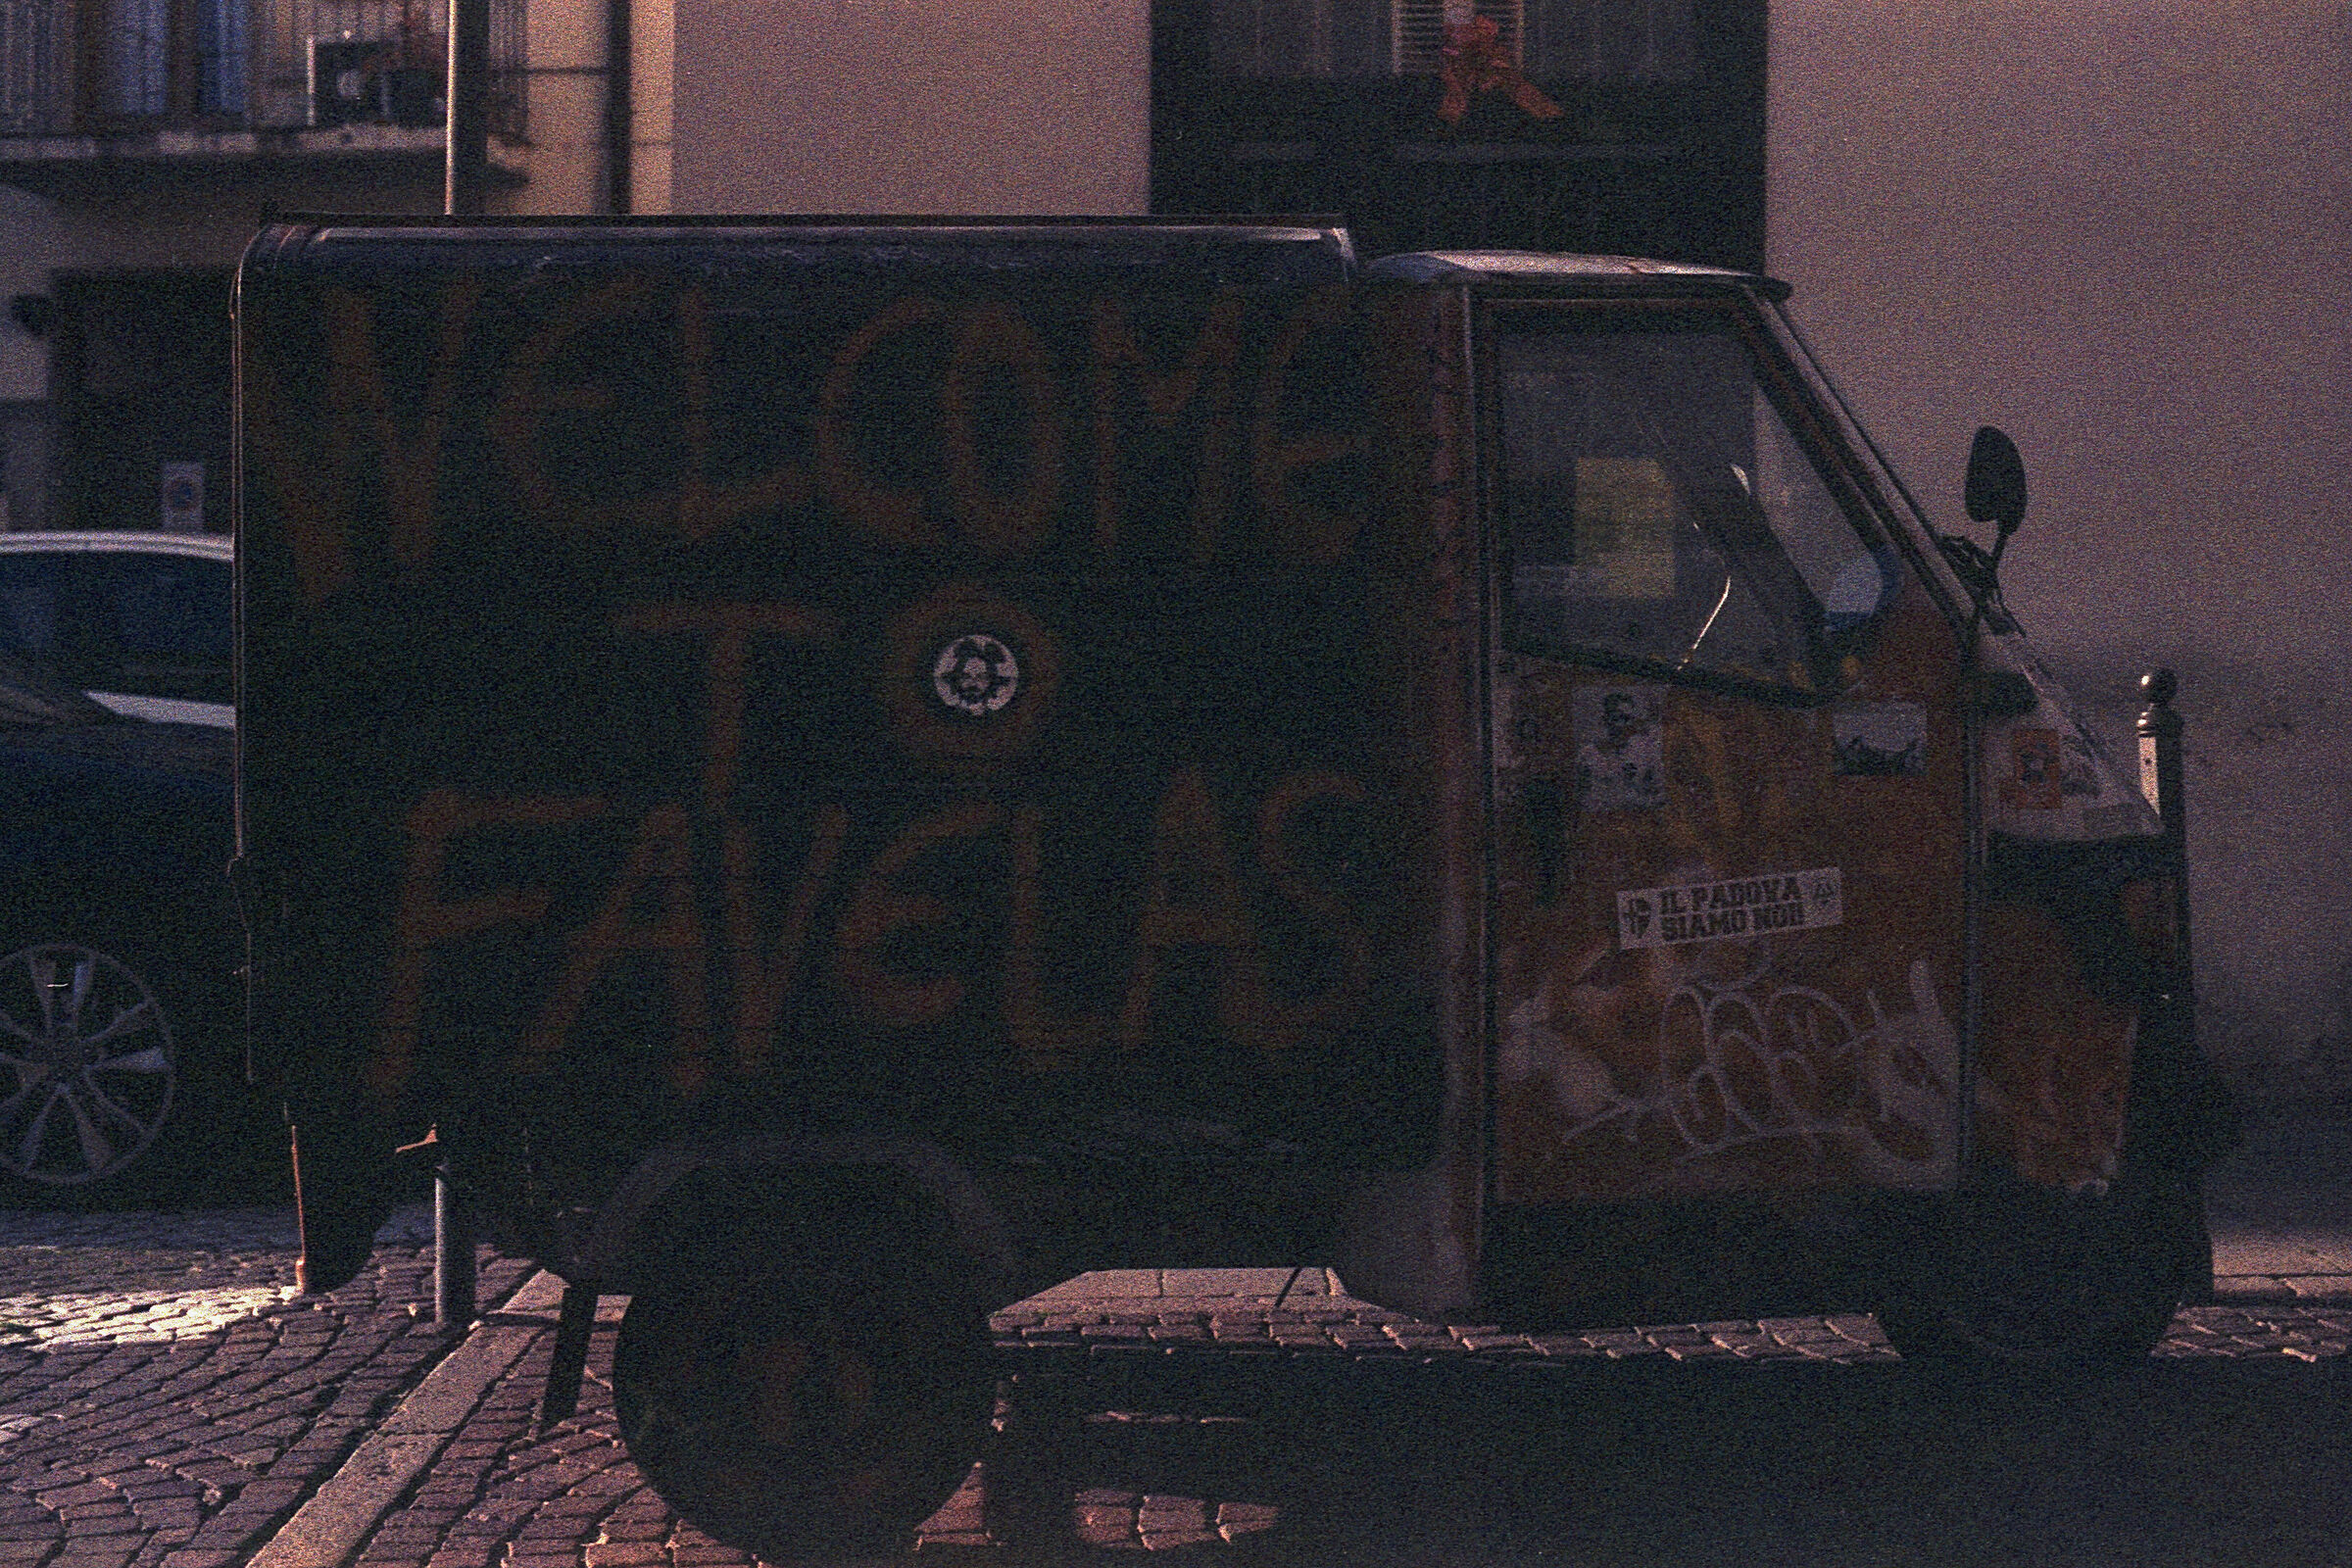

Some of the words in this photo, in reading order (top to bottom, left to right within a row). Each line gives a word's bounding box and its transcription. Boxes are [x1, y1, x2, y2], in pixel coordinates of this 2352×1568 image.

[242, 274, 1374, 610] WELCOME
[608, 580, 1060, 811] TO
[367, 764, 1369, 1109] FAVELAS
[1660, 891, 1686, 914] IL
[1691, 877, 1802, 911] PADOVA
[1660, 909, 1746, 942] SIAMO
